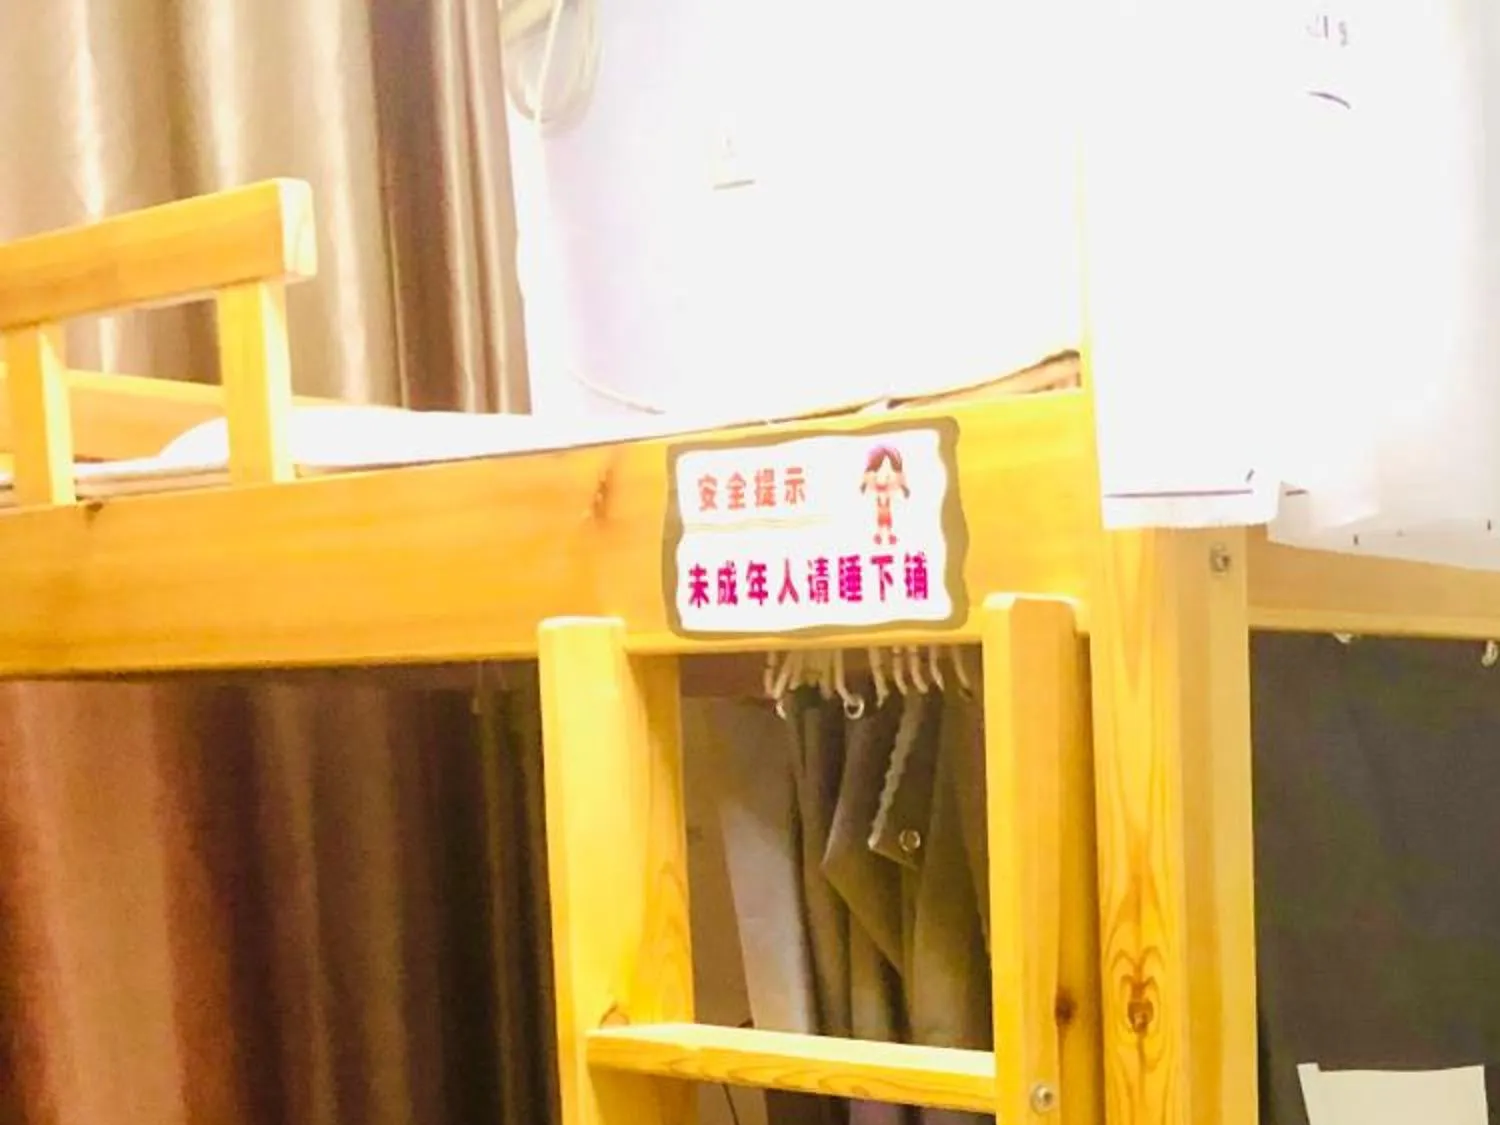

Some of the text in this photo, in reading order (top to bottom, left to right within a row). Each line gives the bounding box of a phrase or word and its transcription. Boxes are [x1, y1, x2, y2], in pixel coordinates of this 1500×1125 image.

[697, 467, 806, 511] 安全提示
[688, 552, 929, 608] 未成年人请睡下铺
